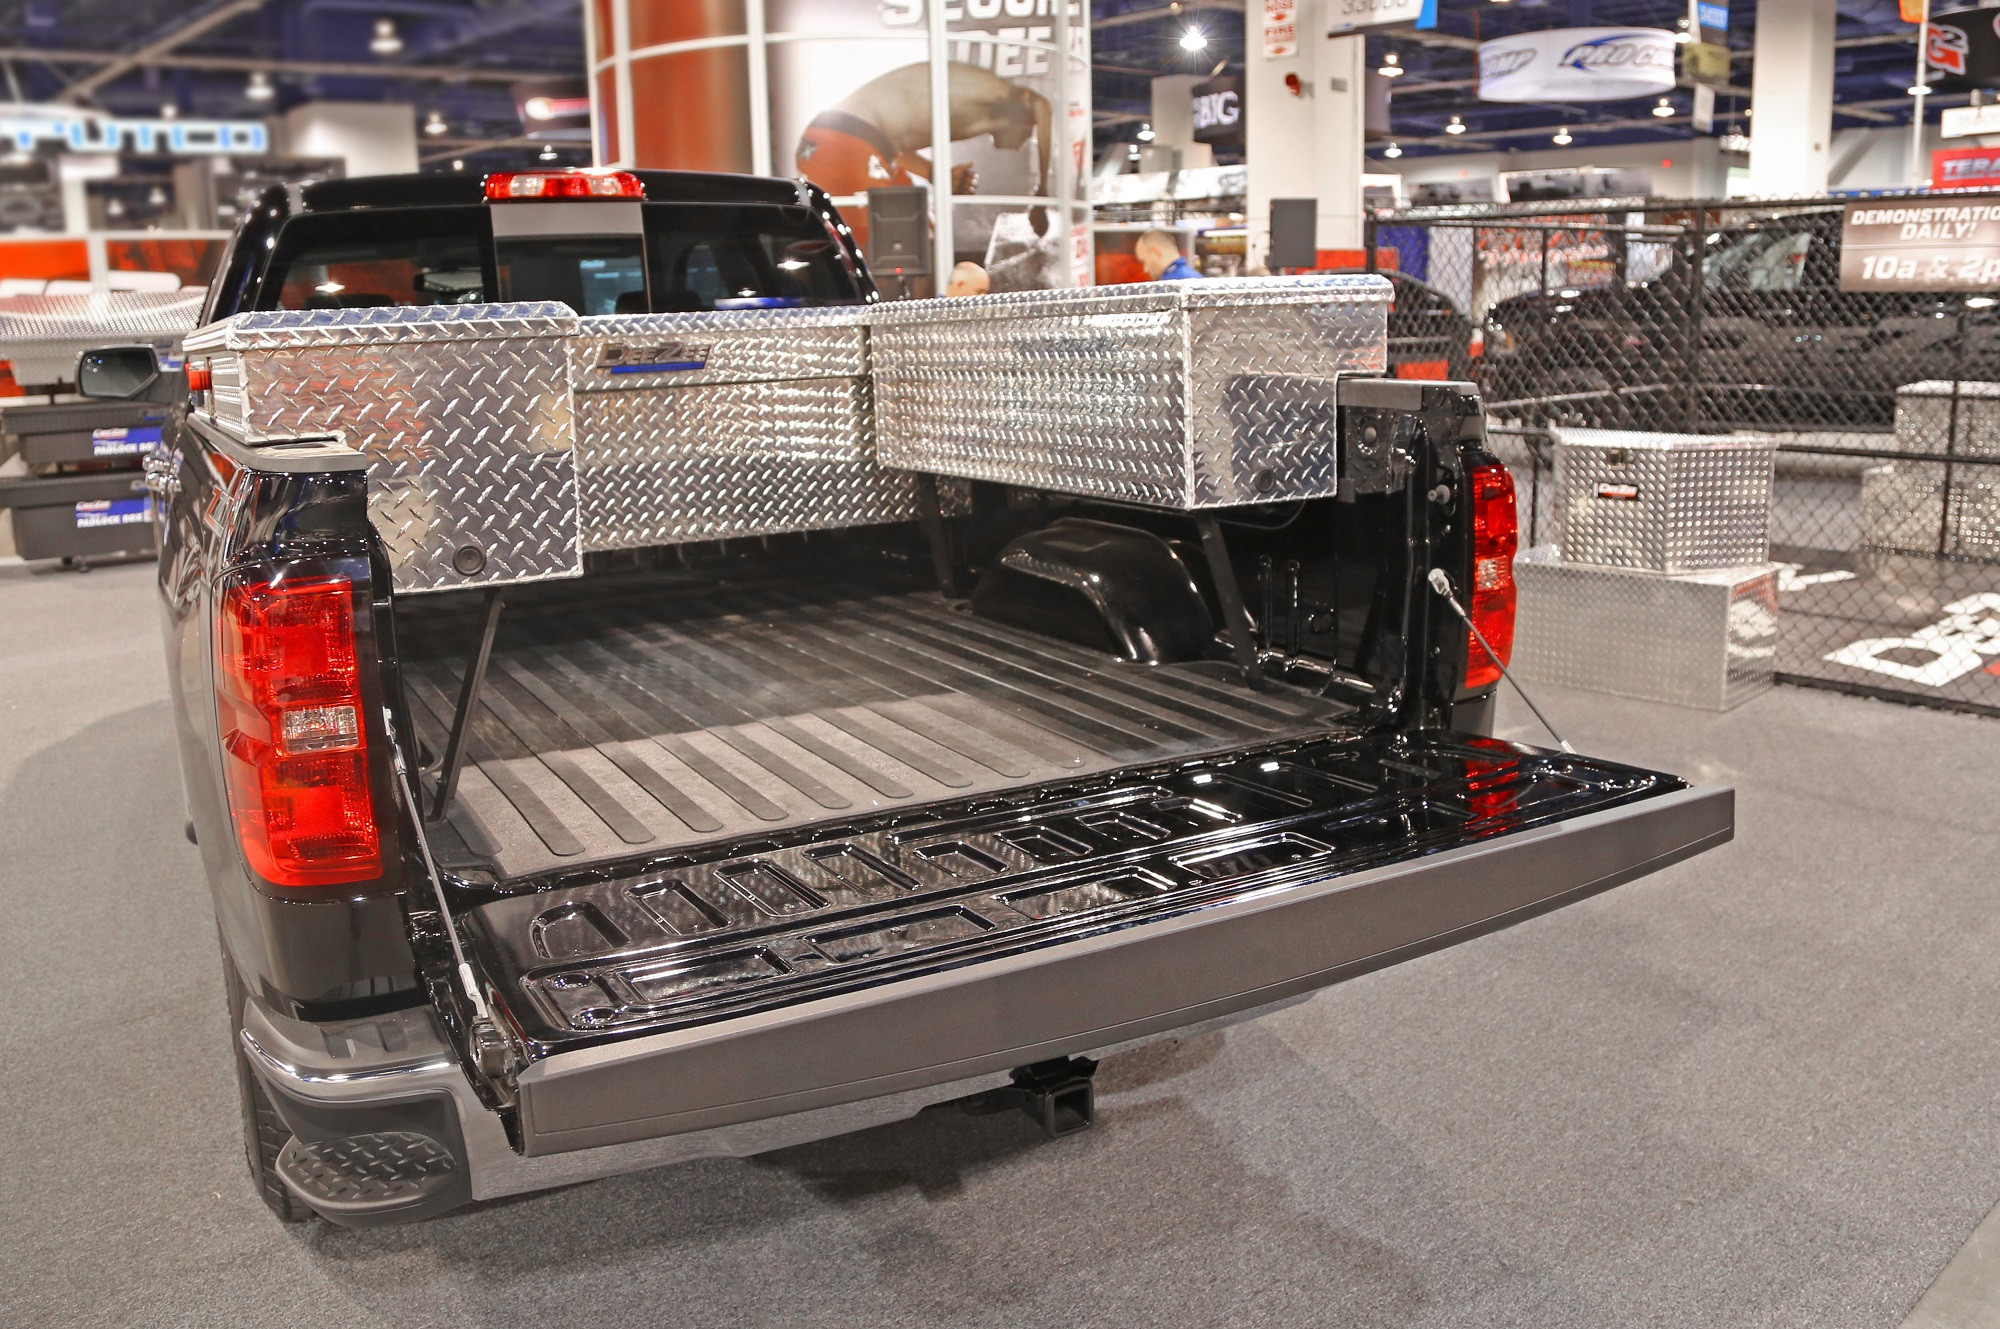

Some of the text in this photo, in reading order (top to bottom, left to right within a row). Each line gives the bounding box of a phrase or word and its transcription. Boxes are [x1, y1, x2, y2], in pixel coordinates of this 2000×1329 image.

[1901, 222, 1978, 241] DAILY!
[1862, 254, 1918, 280] 10a
[1924, 254, 1950, 281] &
